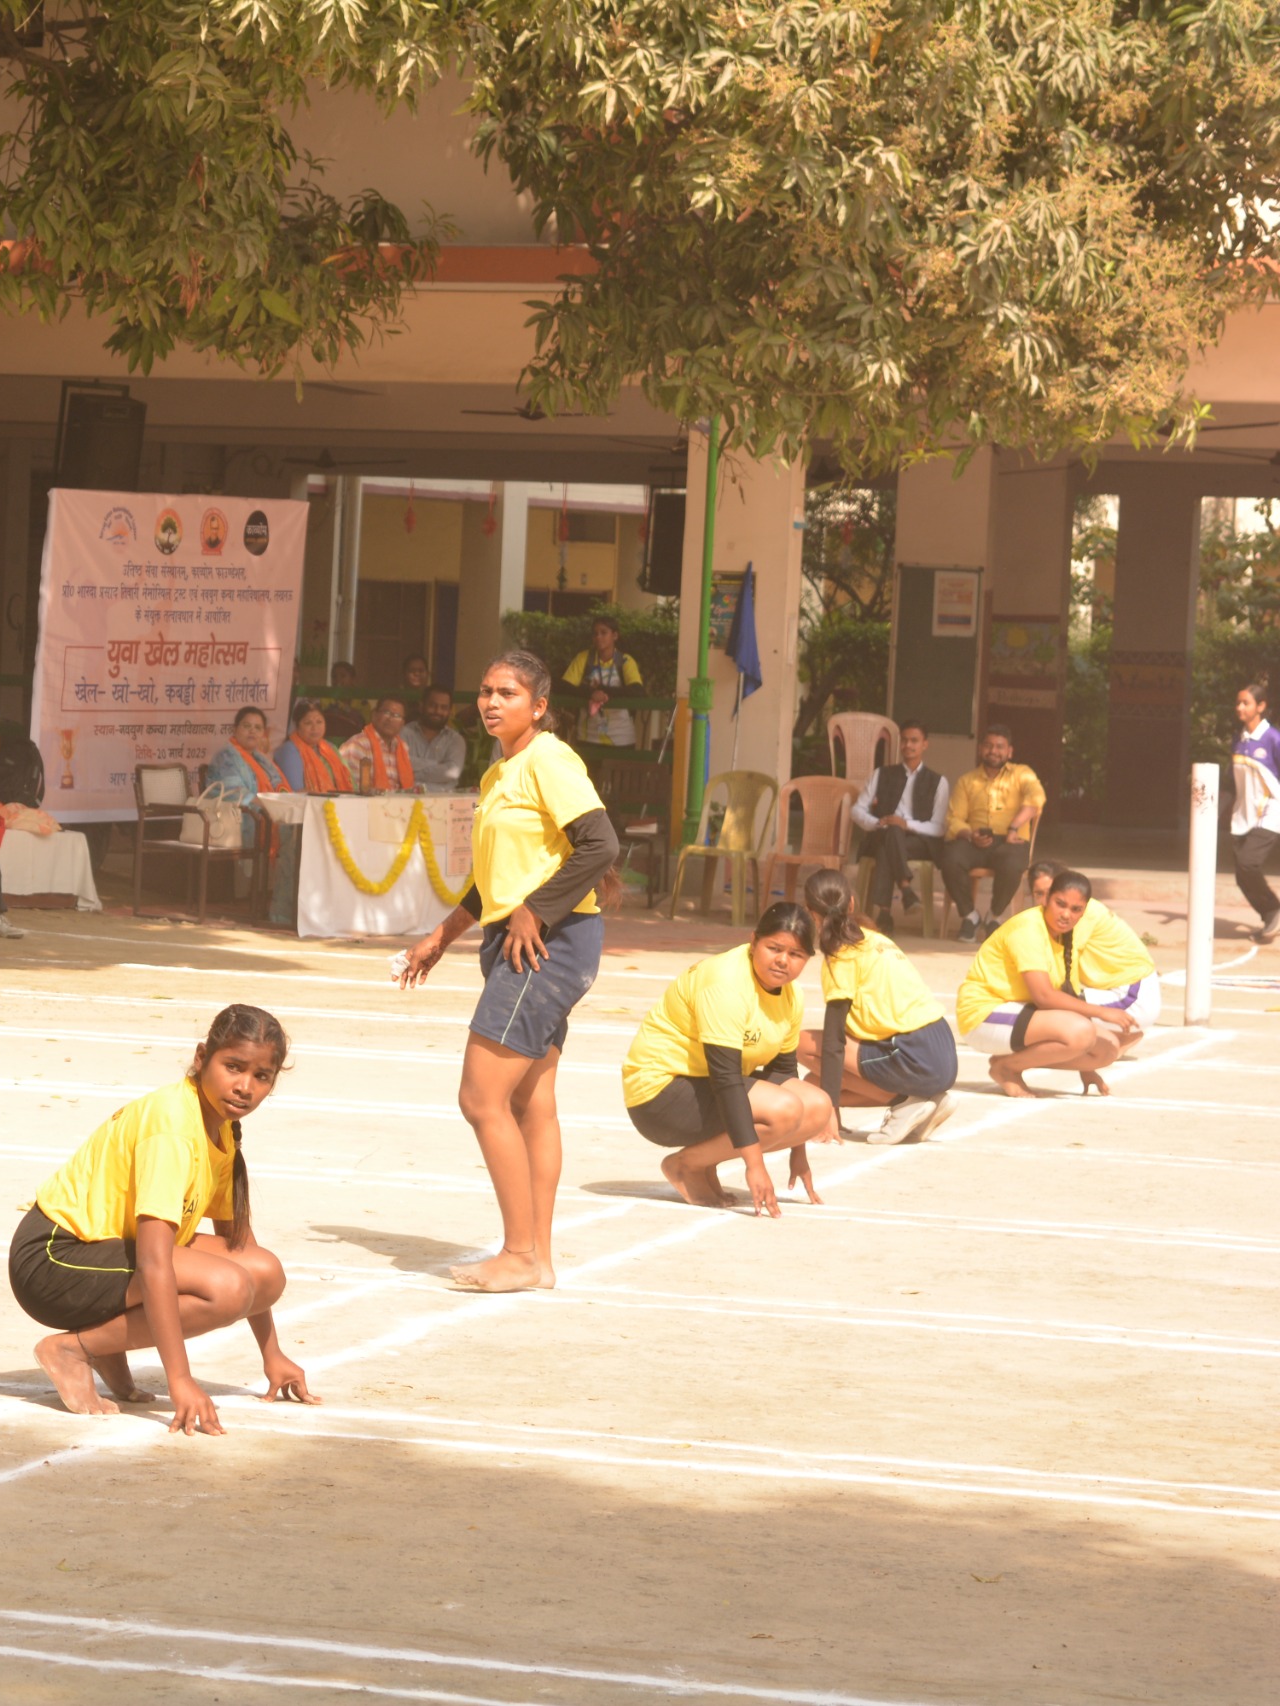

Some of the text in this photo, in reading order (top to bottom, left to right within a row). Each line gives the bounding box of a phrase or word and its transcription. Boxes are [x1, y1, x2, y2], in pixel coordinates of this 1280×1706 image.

[145, 561, 158, 577] सेवा
[99, 586, 118, 600] प्रसाद
[200, 588, 219, 605] नवयुग
[135, 606, 142, 623] के
[195, 607, 203, 624] में
[204, 607, 231, 625] आयोजित
[107, 632, 249, 679] युवा खेल महोत्सव
[165, 677, 195, 705] कबड्डी
[200, 676, 222, 703] और
[225, 678, 269, 703] वॉलीबॉल
[146, 723, 167, 736] कन्या
[168, 742, 185, 760] मार्च
[187, 747, 207, 760] 2025
[108, 772, 128, 787] आप
